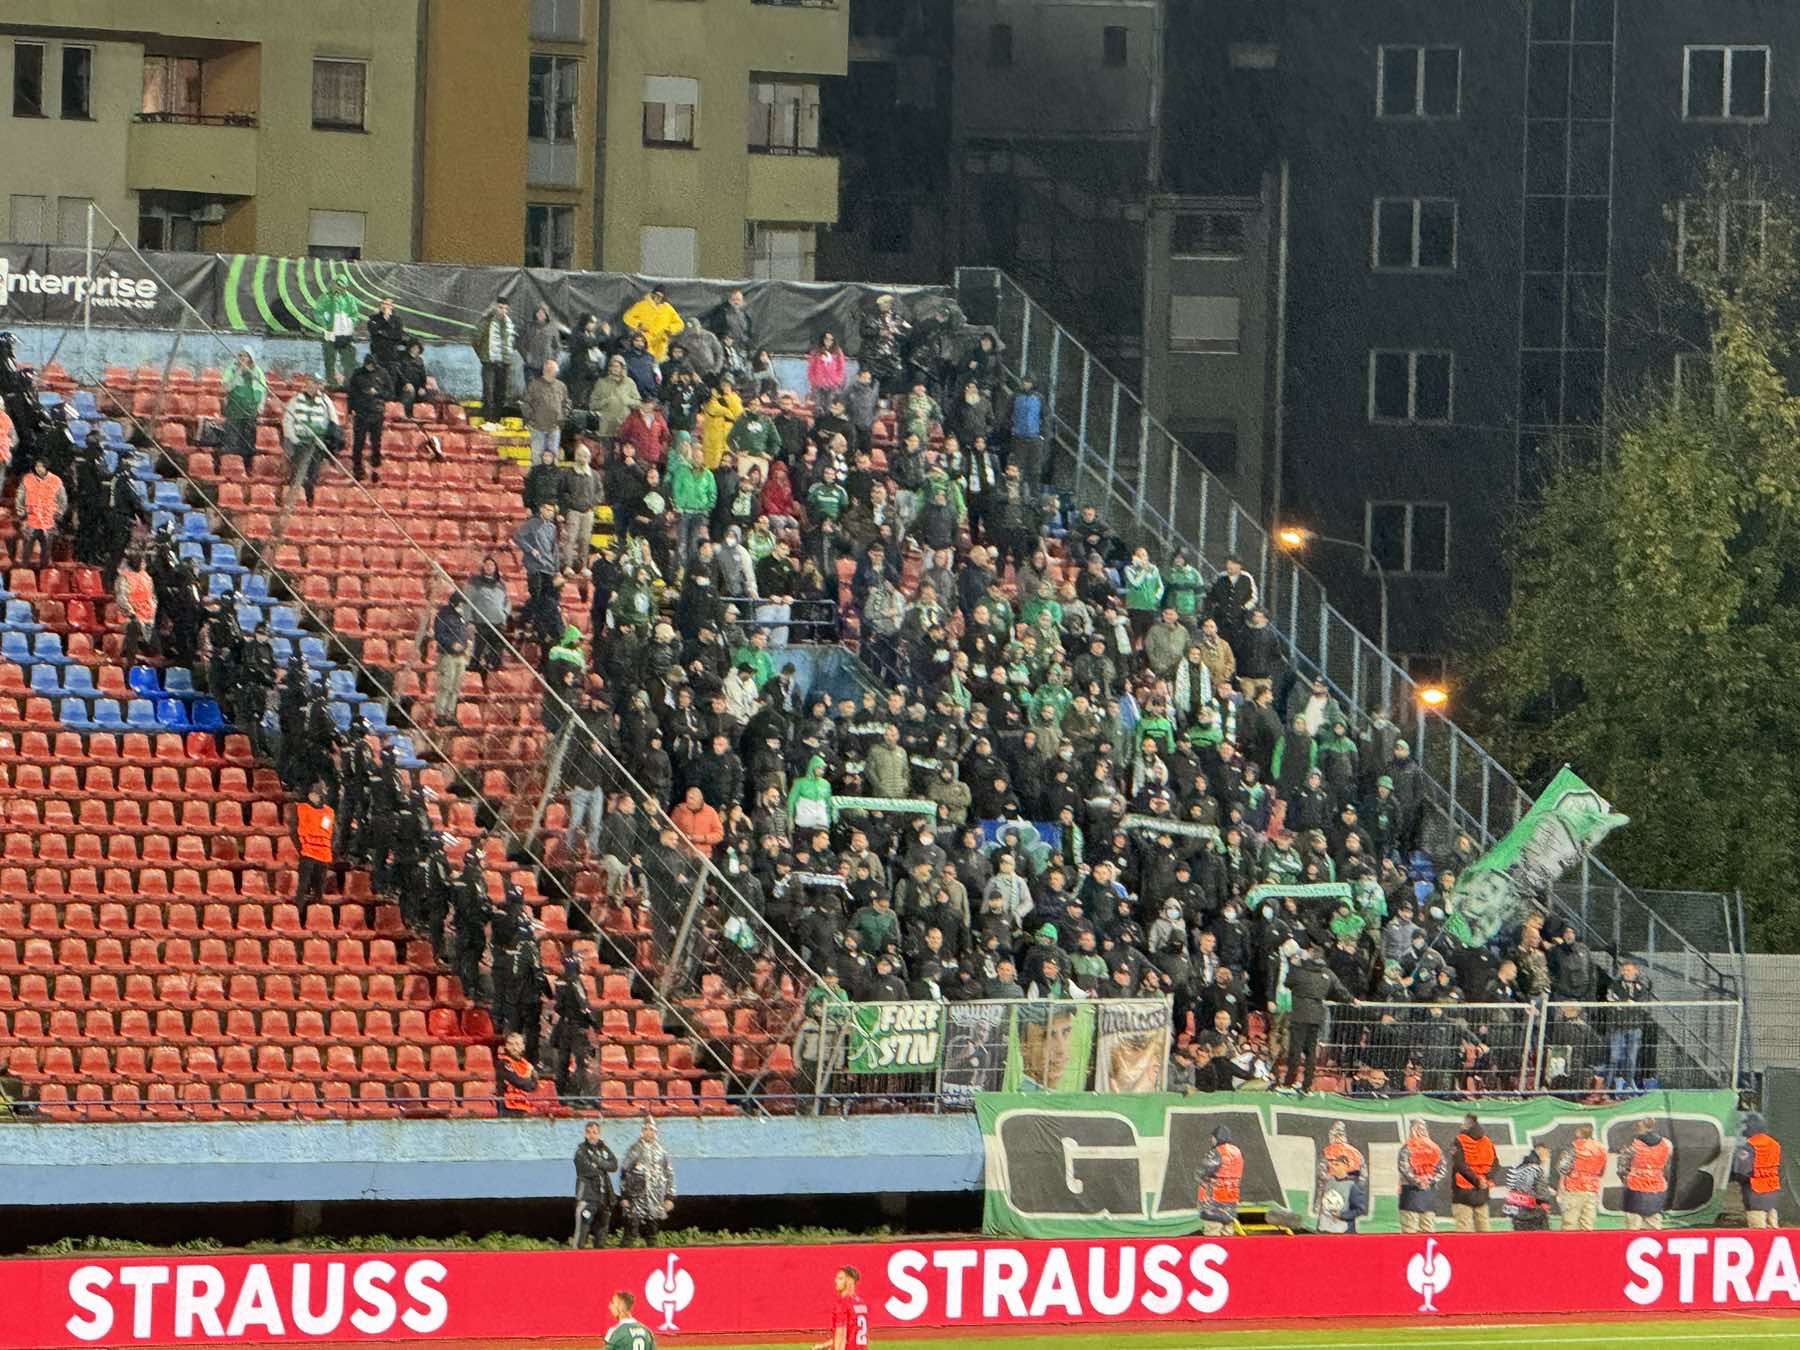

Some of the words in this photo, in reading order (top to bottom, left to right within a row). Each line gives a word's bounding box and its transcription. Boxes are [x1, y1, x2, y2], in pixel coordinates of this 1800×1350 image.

[0, 269, 158, 302] nterprise
[879, 1005, 941, 1032] FREE
[878, 1031, 939, 1066] STN
[885, 1243, 1230, 1321] STRAUSS
[66, 1259, 449, 1341] STRAUSS
[855, 1314, 868, 1346] 2
